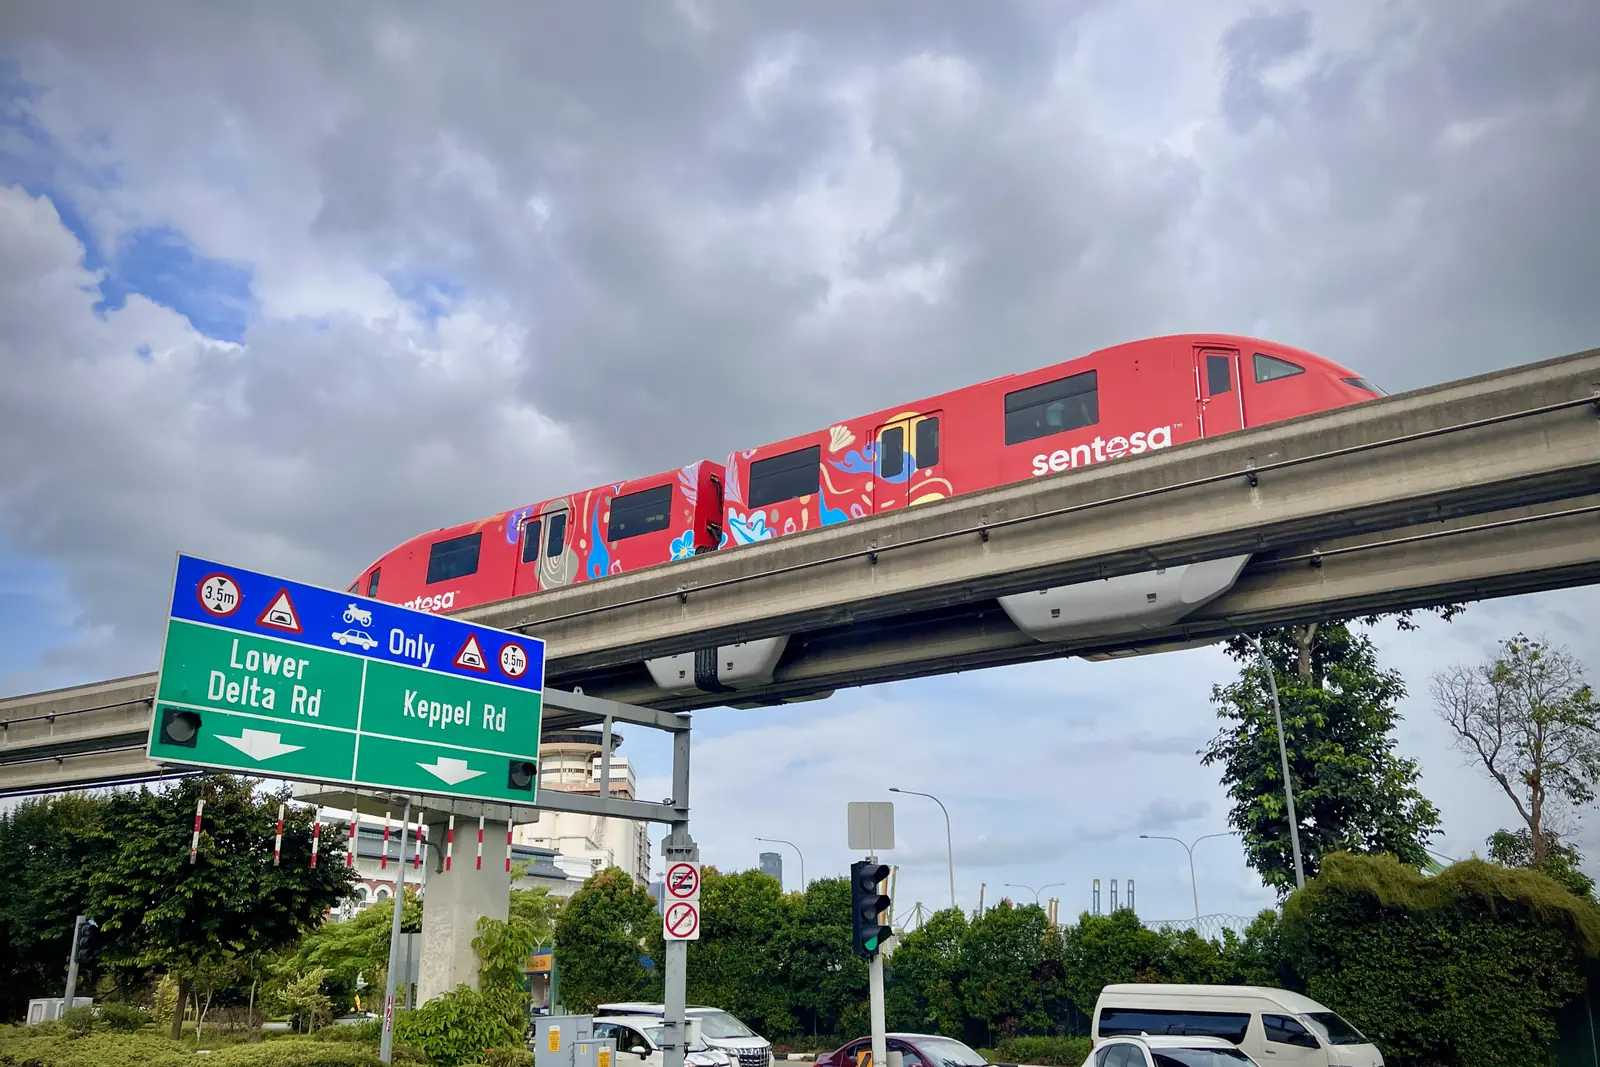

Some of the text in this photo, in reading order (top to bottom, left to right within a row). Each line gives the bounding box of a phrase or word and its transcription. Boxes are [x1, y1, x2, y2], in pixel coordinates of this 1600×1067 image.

[1031, 425, 1172, 476] sentosa
[205, 585, 235, 605] 3.5m
[230, 638, 309, 680] Lower
[389, 628, 435, 668] Only
[503, 652, 524, 668] 3.5m
[207, 670, 322, 717] Delta Rd
[403, 689, 507, 732] Keppel Rd
